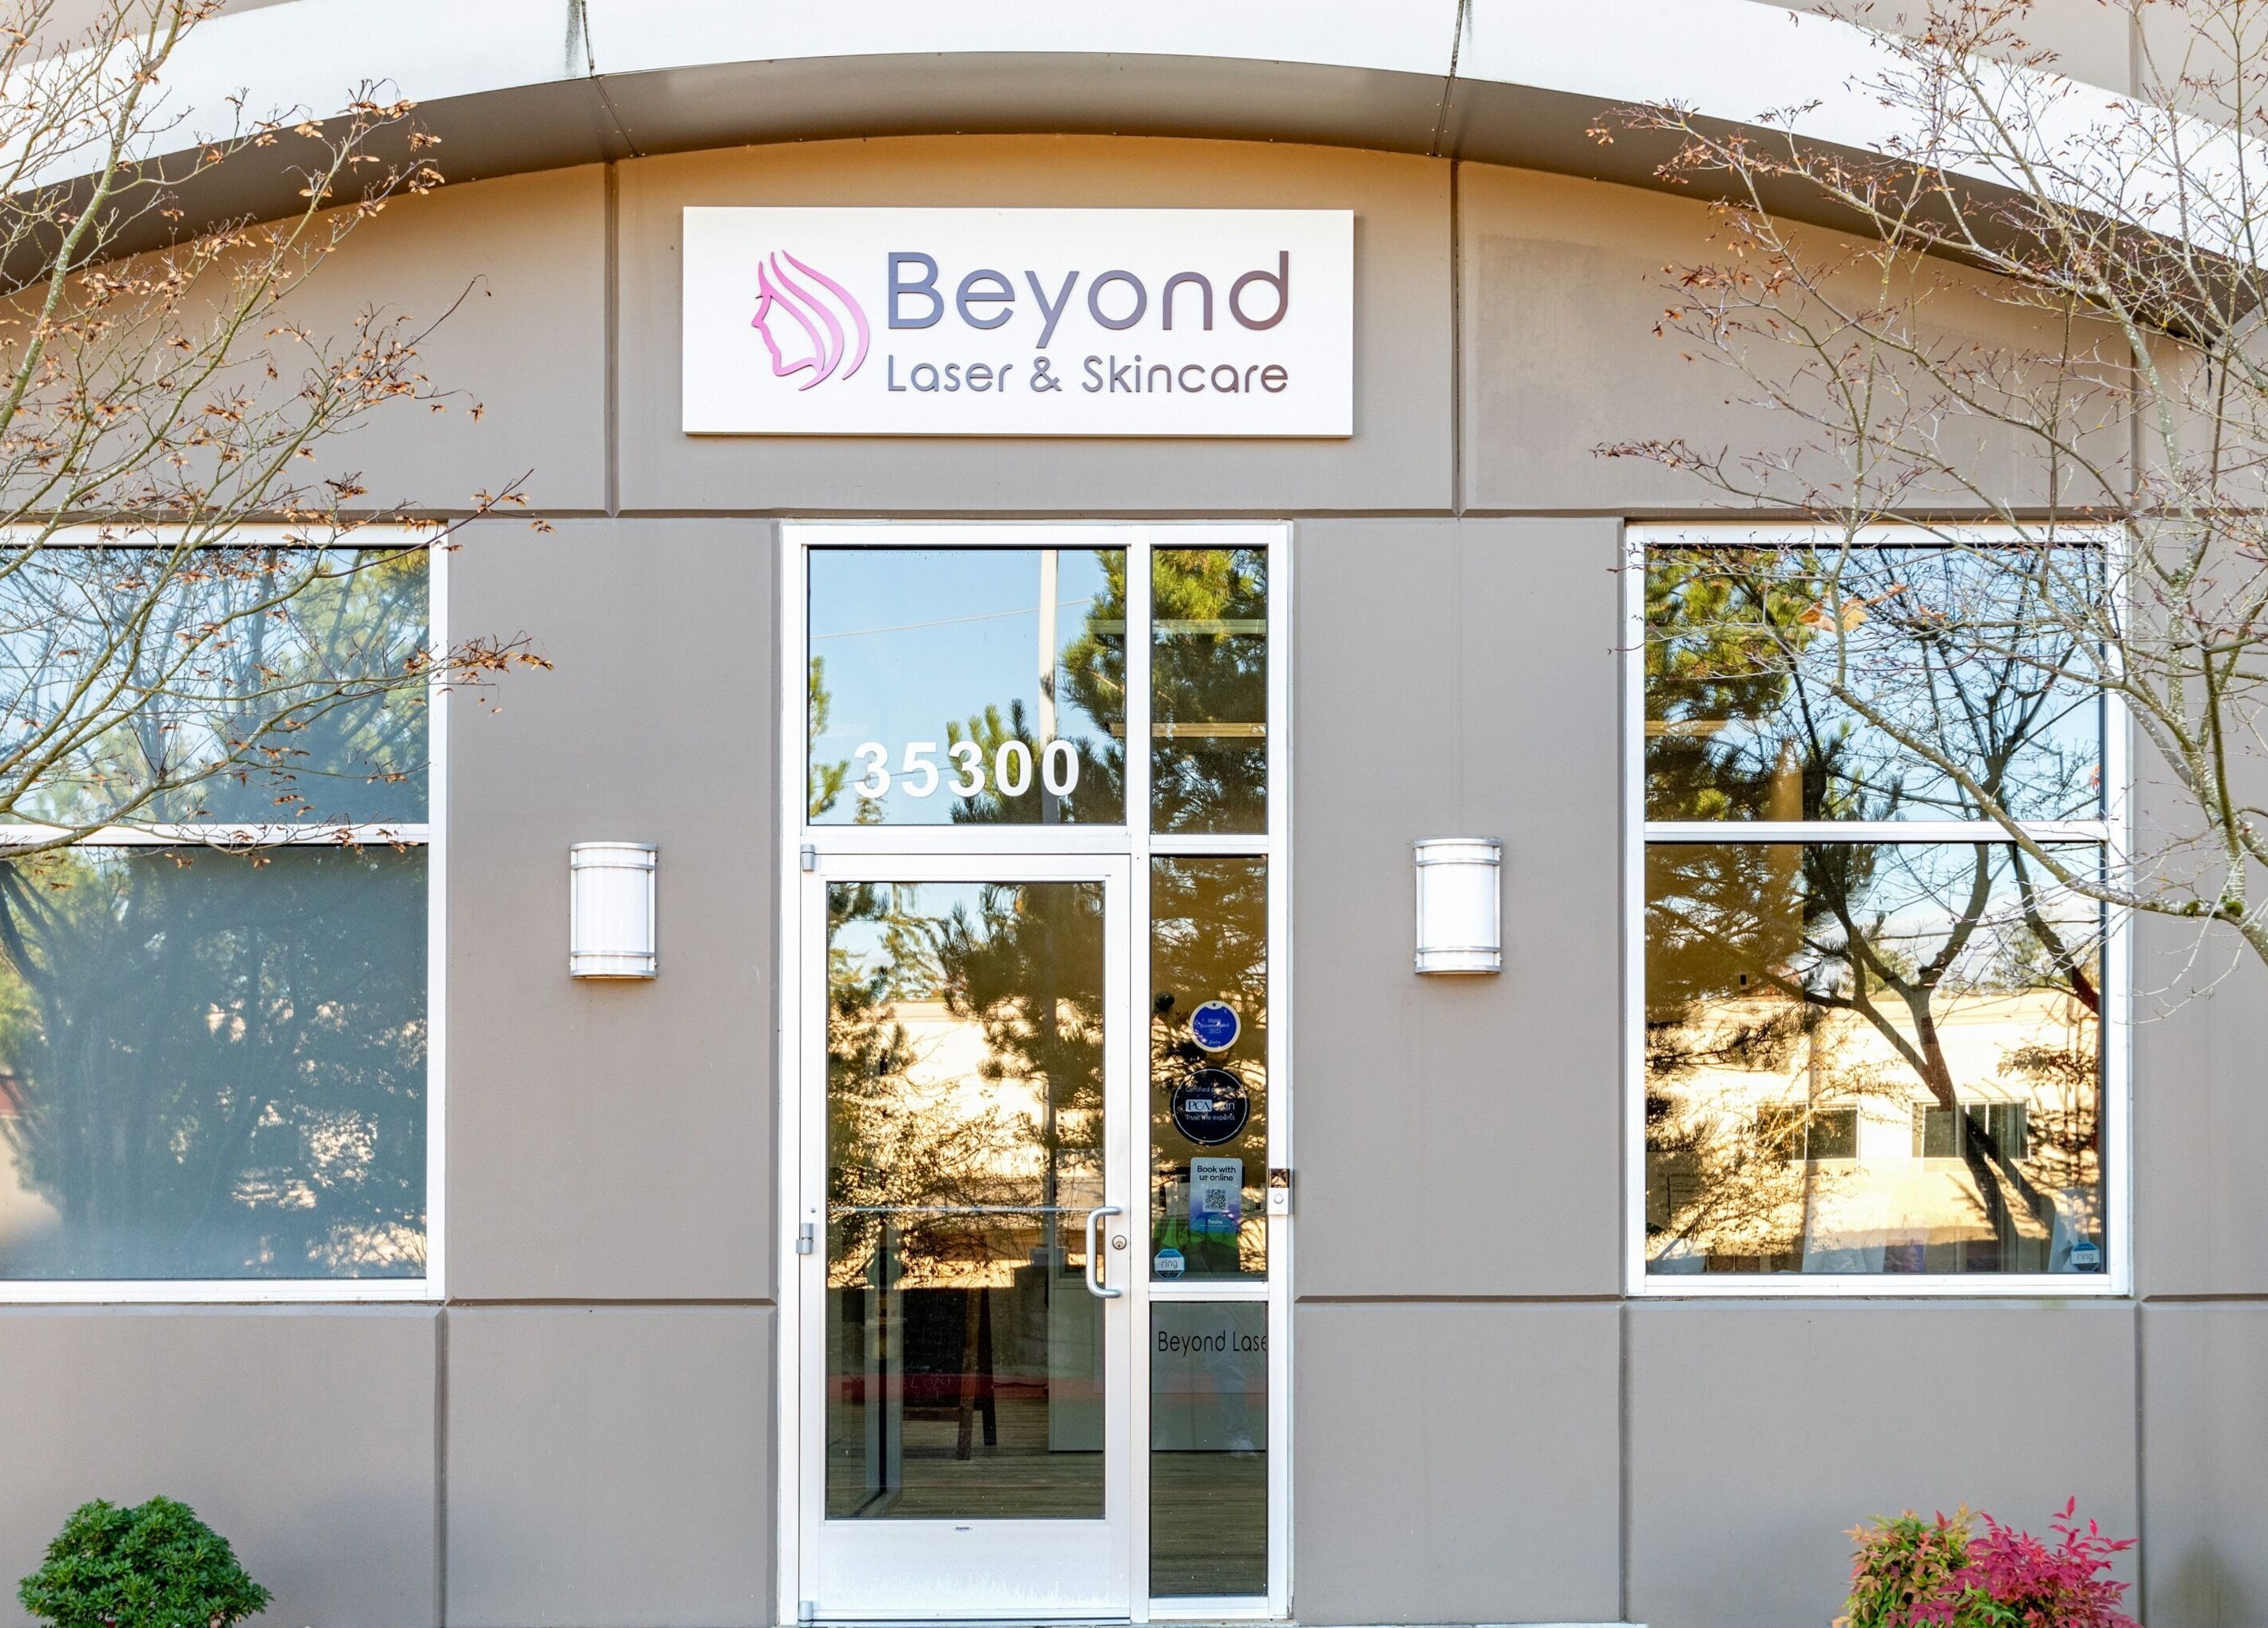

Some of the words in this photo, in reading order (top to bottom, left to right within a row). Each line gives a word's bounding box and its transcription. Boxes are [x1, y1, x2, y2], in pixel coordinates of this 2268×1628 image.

[888, 250, 1289, 348] Beyond
[888, 355, 1012, 391] Laser
[1031, 355, 1062, 391] &
[1083, 355, 1288, 393] Skincare
[853, 739, 1080, 799] 35300
[1188, 1101, 1210, 1110] PCA
[1161, 1258, 1178, 1269] ring
[2078, 1252, 2093, 1261] ring
[1158, 1330, 1226, 1356] Beyond
